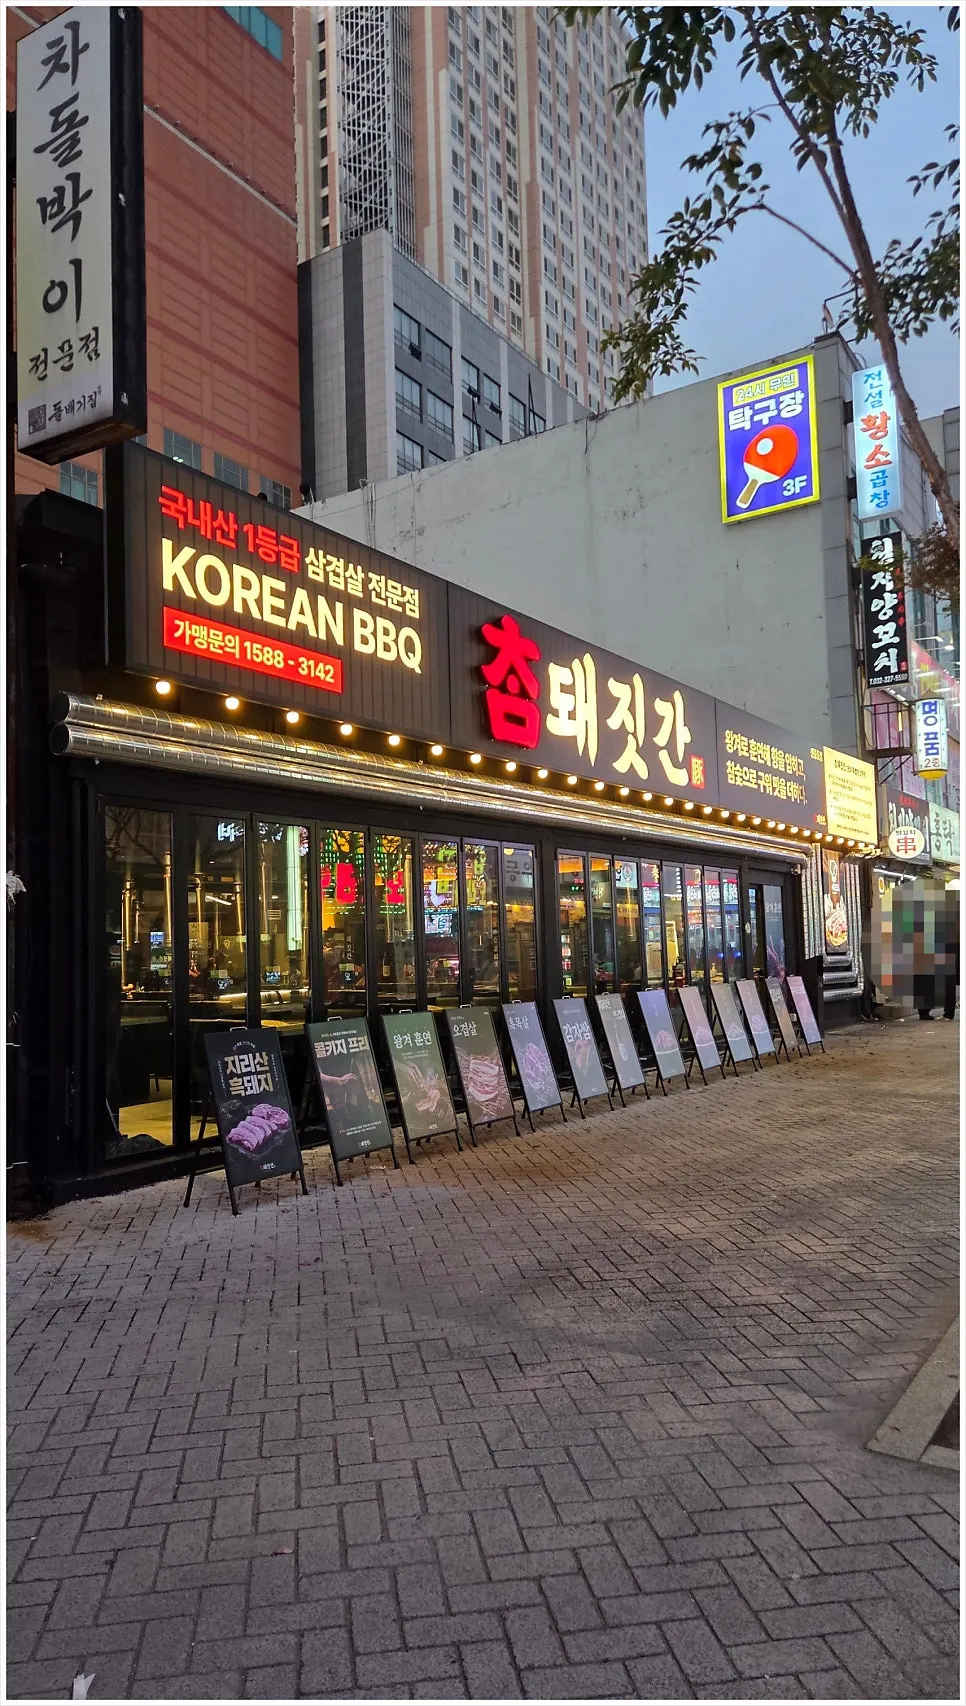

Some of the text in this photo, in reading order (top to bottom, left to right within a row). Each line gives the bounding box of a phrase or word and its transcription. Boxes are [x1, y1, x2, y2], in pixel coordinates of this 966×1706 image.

[33, 21, 93, 325] 차돌박이
[29, 326, 101, 381] 전문점
[736, 374, 796, 402] 24시 무인
[728, 391, 806, 431] 탁구장
[782, 474, 808, 497] 3F
[158, 485, 420, 619] 국내산 1등급 삼겹살 전문점
[161, 538, 423, 674] KOREAN BBQ
[173, 619, 240, 659] 가맹문의
[243, 640, 285, 669] 1588
[297, 655, 335, 683] 3142
[480, 613, 692, 787] 참돼짓간
[921, 700, 940, 756] 명품
[725, 729, 749, 757] 왕겨로
[771, 746, 785, 772] 향을
[726, 760, 758, 789] 참숯으로
[758, 771, 773, 796] 구워
[773, 776, 787, 800] 맛을
[896, 835, 917, 854] 串
[314, 1035, 369, 1059] 콜키지 프리
[393, 1030, 432, 1049] 왕겨 훈연
[452, 1020, 478, 1038] 오겹살
[224, 1051, 270, 1076] 지리산
[229, 1073, 274, 1097] 흑돼지
